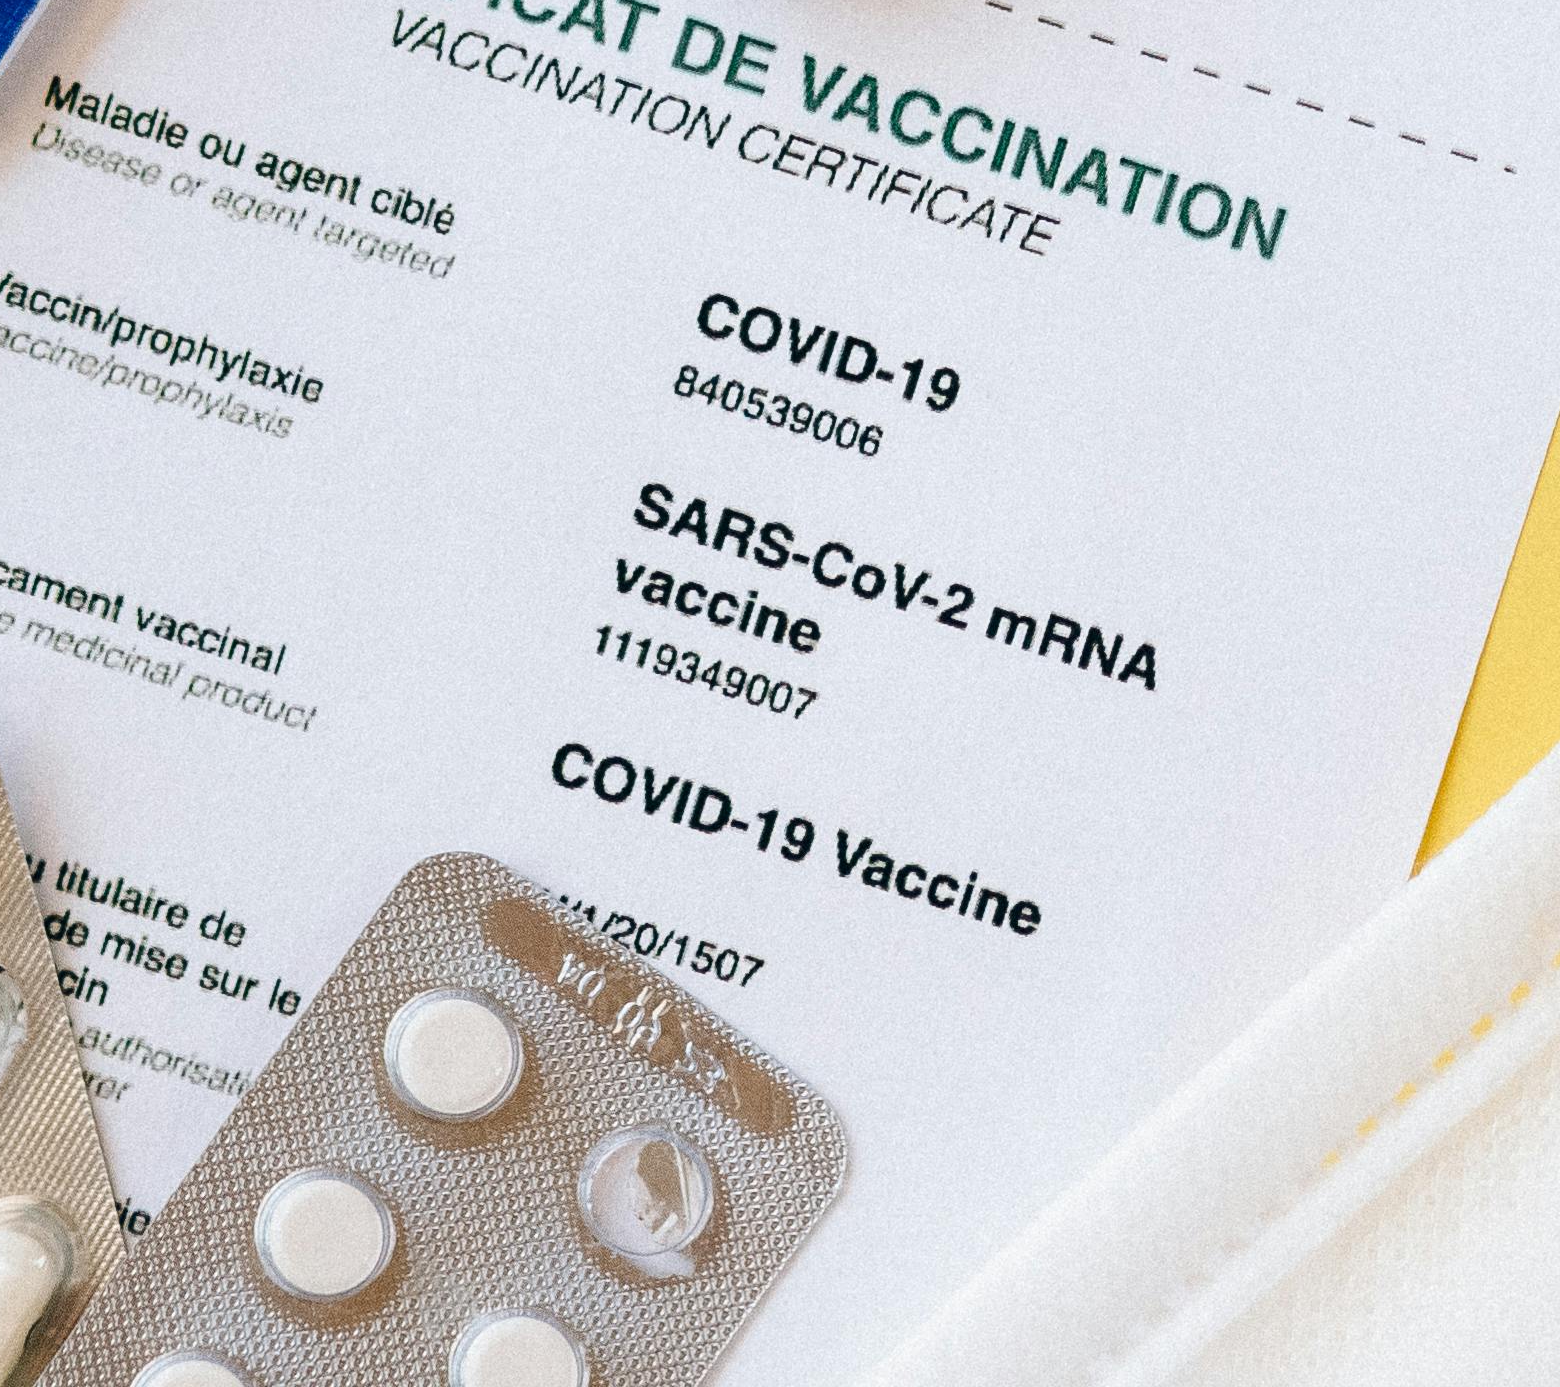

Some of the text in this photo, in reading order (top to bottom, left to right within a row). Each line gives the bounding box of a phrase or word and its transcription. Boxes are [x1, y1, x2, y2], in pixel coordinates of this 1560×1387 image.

[43, 74, 455, 235] Maladie ou agent ciblé
[391, 8, 1061, 256] VACCINATION CERTIFICATE
[670, 16, 777, 96] DE
[802, 53, 1287, 260] VACCINATION
[28, 118, 456, 278] Disease or agent targeted
[673, 364, 883, 457] 840539006
[696, 292, 960, 412] COVID-19
[136, 606, 286, 675] vaccinal
[615, 557, 821, 653] vaccine
[632, 482, 1156, 691] SARS-CoV-2 mRNA
[596, 624, 818, 719] 1119349007
[551, 742, 1041, 936] COVID-19 Vaccine
[54, 860, 189, 929] titulaire
[198, 909, 246, 948] de
[99, 931, 188, 980] mise
[198, 964, 259, 1001] sur
[267, 977, 301, 1016] le
